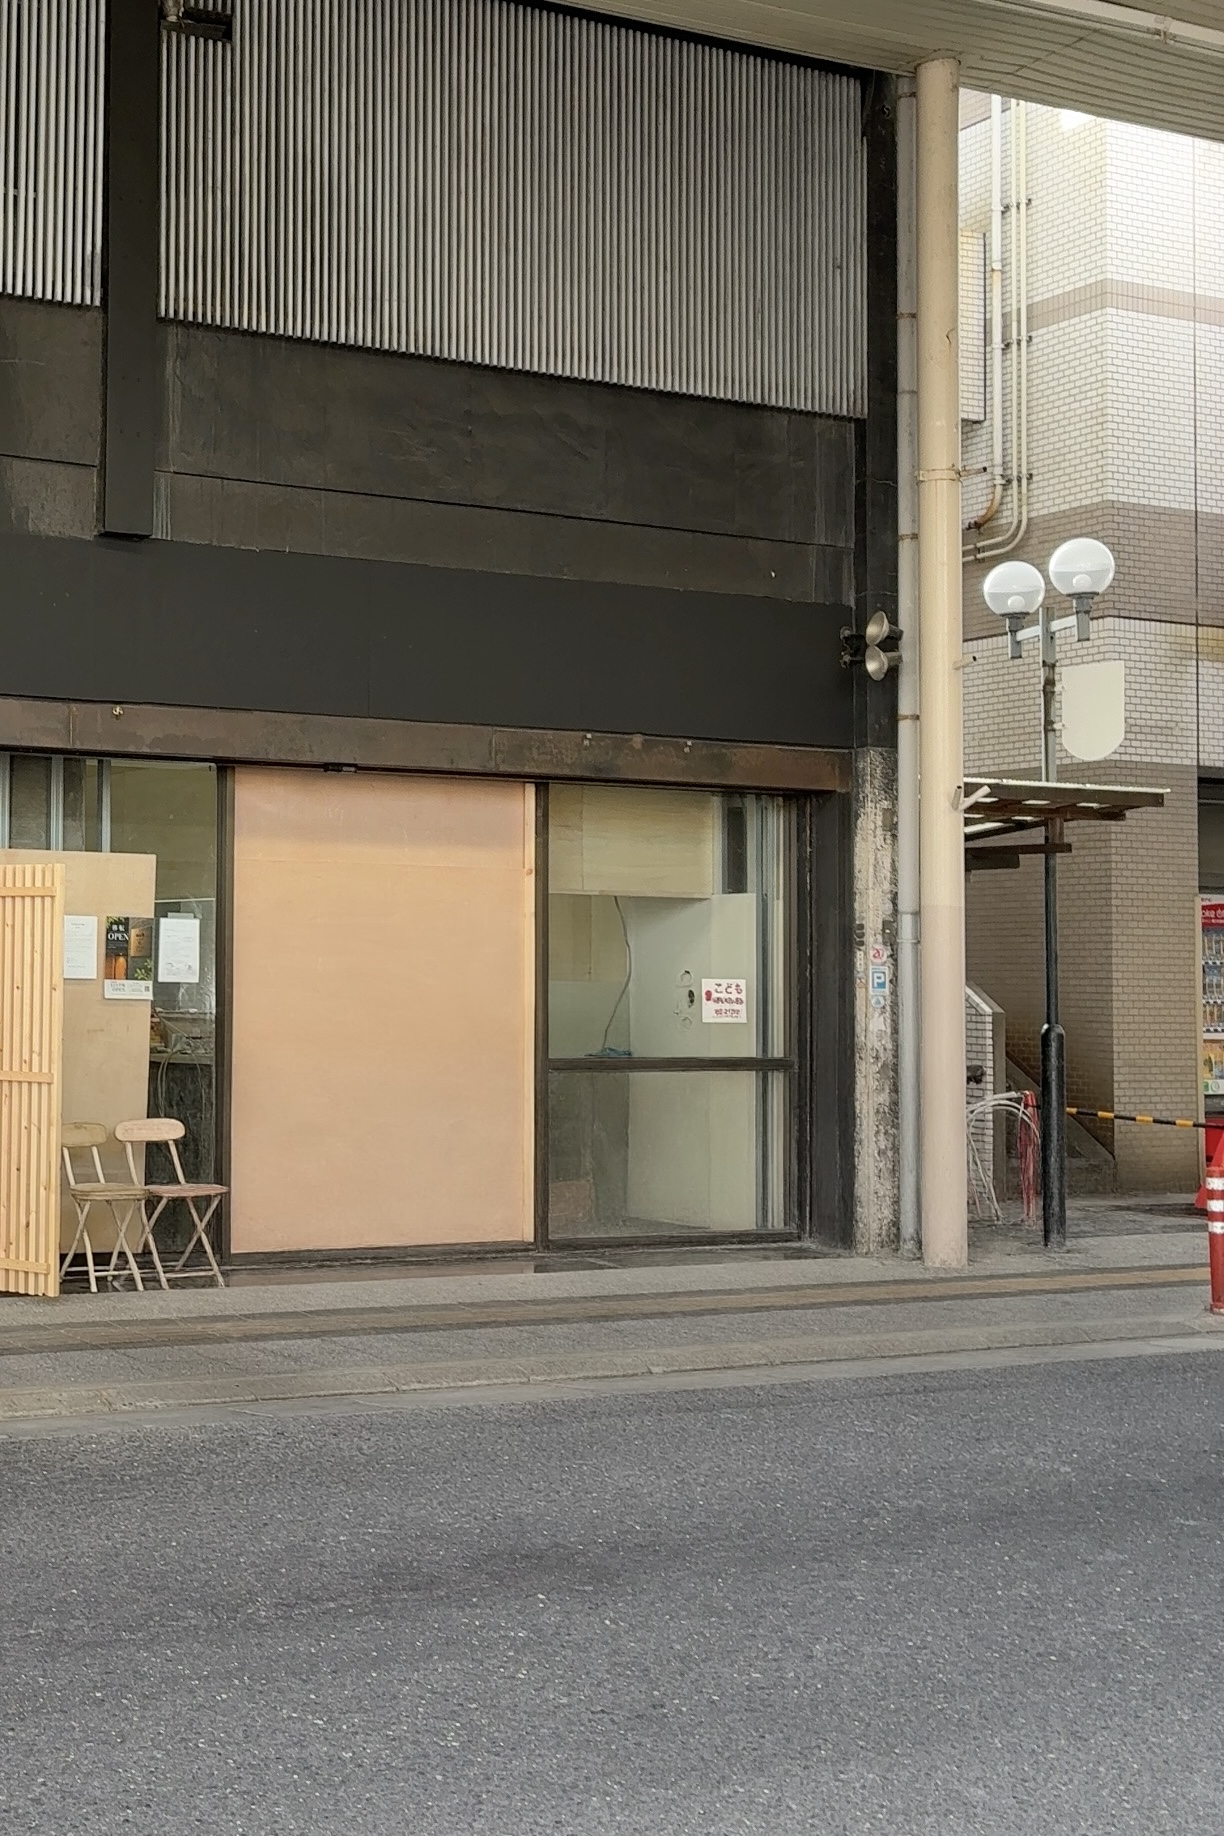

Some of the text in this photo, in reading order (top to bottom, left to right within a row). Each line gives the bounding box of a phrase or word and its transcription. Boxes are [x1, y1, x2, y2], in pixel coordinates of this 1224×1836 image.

[107, 932, 129, 941] OPEN
[873, 972, 885, 988] P
[714, 983, 743, 995] こども
